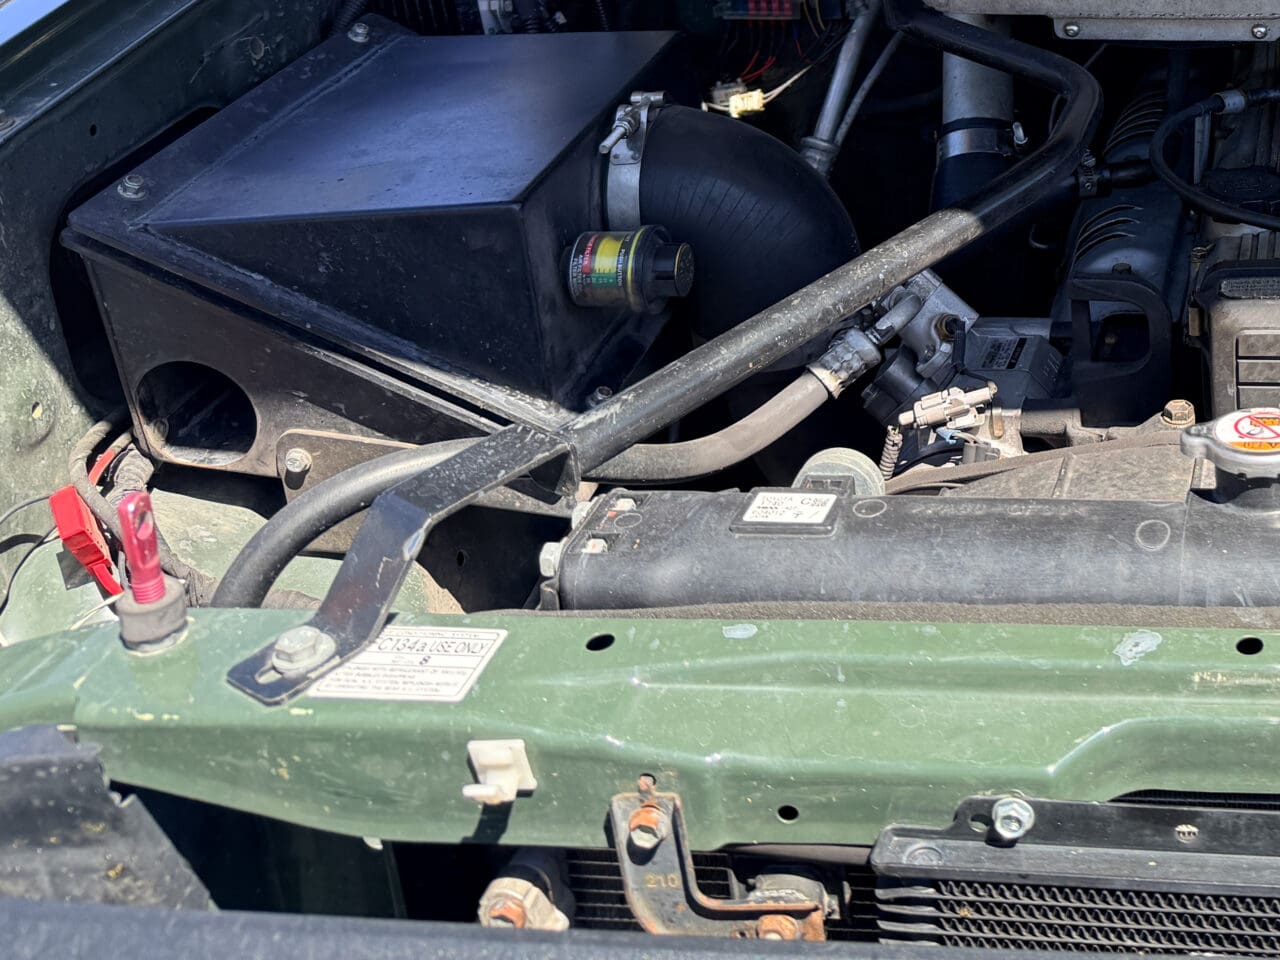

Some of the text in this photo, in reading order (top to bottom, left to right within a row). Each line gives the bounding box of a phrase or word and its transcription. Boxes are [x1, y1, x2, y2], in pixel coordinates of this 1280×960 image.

[378, 637, 488, 654] C134a USE ONLY
[646, 873, 681, 889] 210
